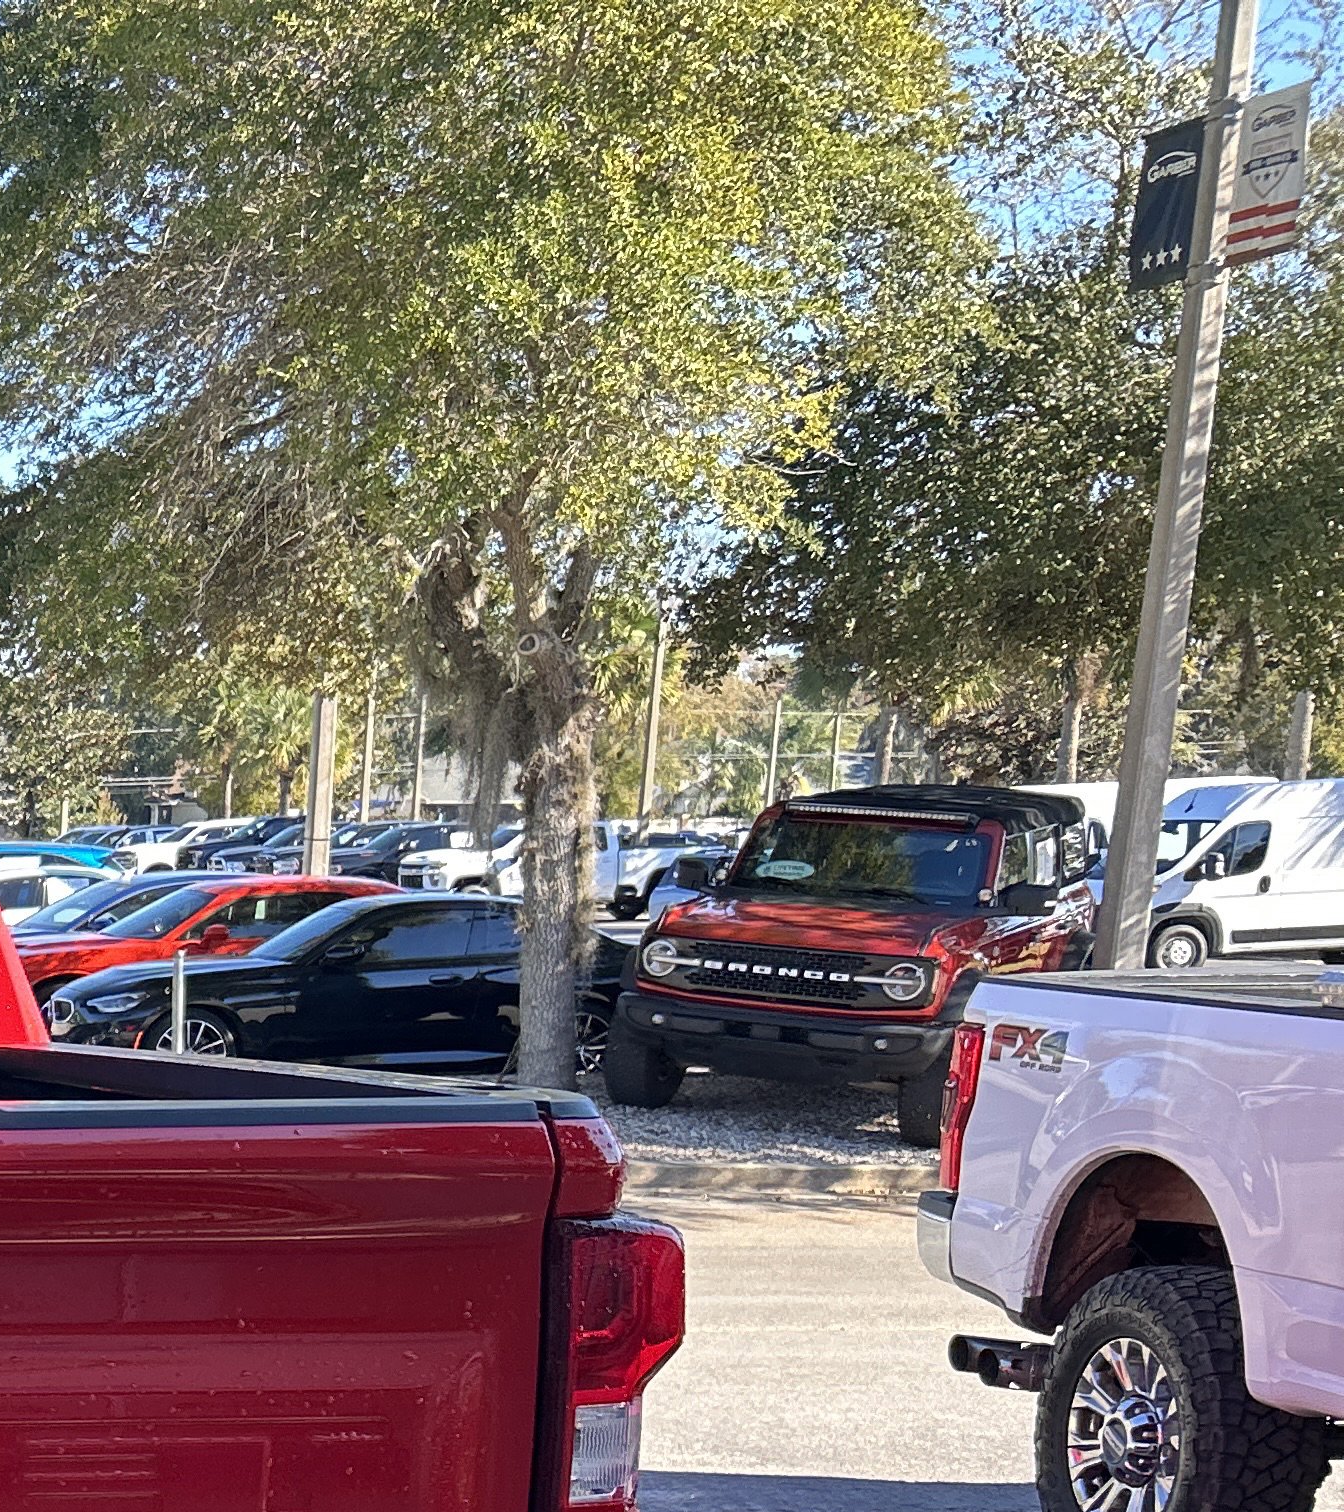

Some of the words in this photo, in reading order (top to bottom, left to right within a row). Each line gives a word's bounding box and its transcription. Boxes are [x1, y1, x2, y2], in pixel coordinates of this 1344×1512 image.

[1147, 155, 1197, 183] GARBER
[703, 959, 850, 982] BRONCO
[989, 1023, 1070, 1065] FX4
[1019, 1060, 1036, 1070] OFF
